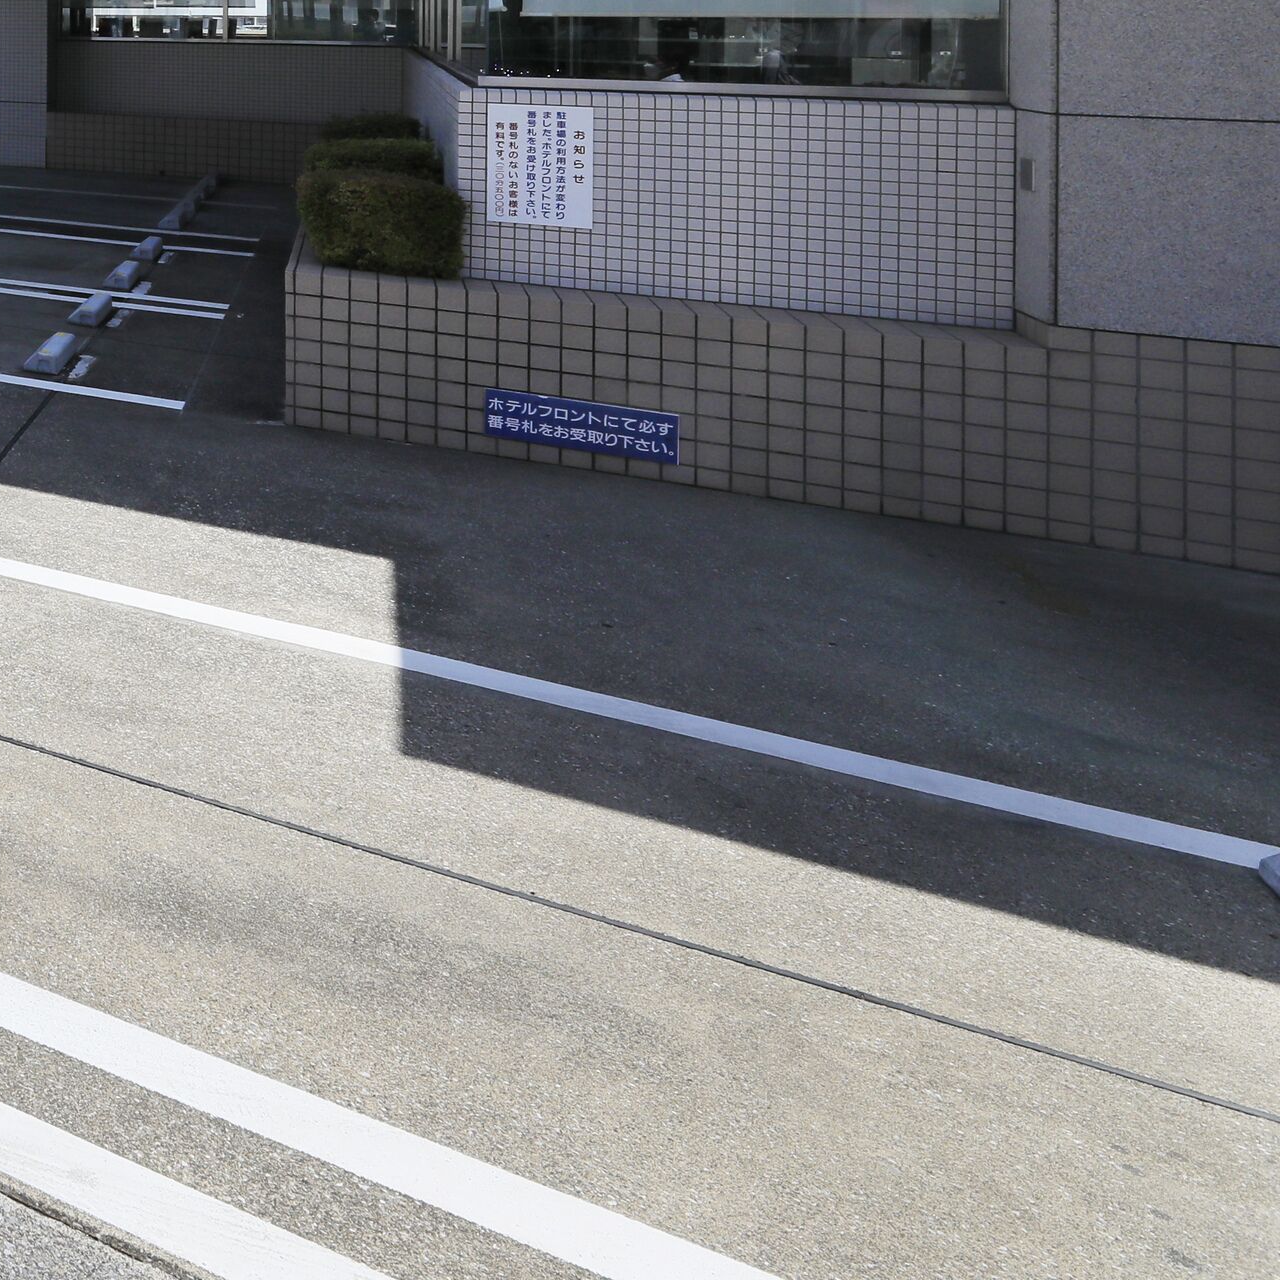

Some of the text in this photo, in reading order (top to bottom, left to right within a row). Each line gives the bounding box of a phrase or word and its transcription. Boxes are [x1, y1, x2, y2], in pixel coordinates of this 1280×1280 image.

[508, 122, 519, 217] 番号札のないお客様は
[526, 110, 537, 219] 番号札をお受け取り下さい。
[541, 111, 552, 219] ました。ホテルフロントにて
[555, 111, 567, 220] 駐車場の利用方法が変わり
[573, 130, 586, 184] お知らせ
[487, 414, 675, 457] 番号札をお受取り下さい。
[488, 397, 674, 436] ホテルフロントにて必ず
